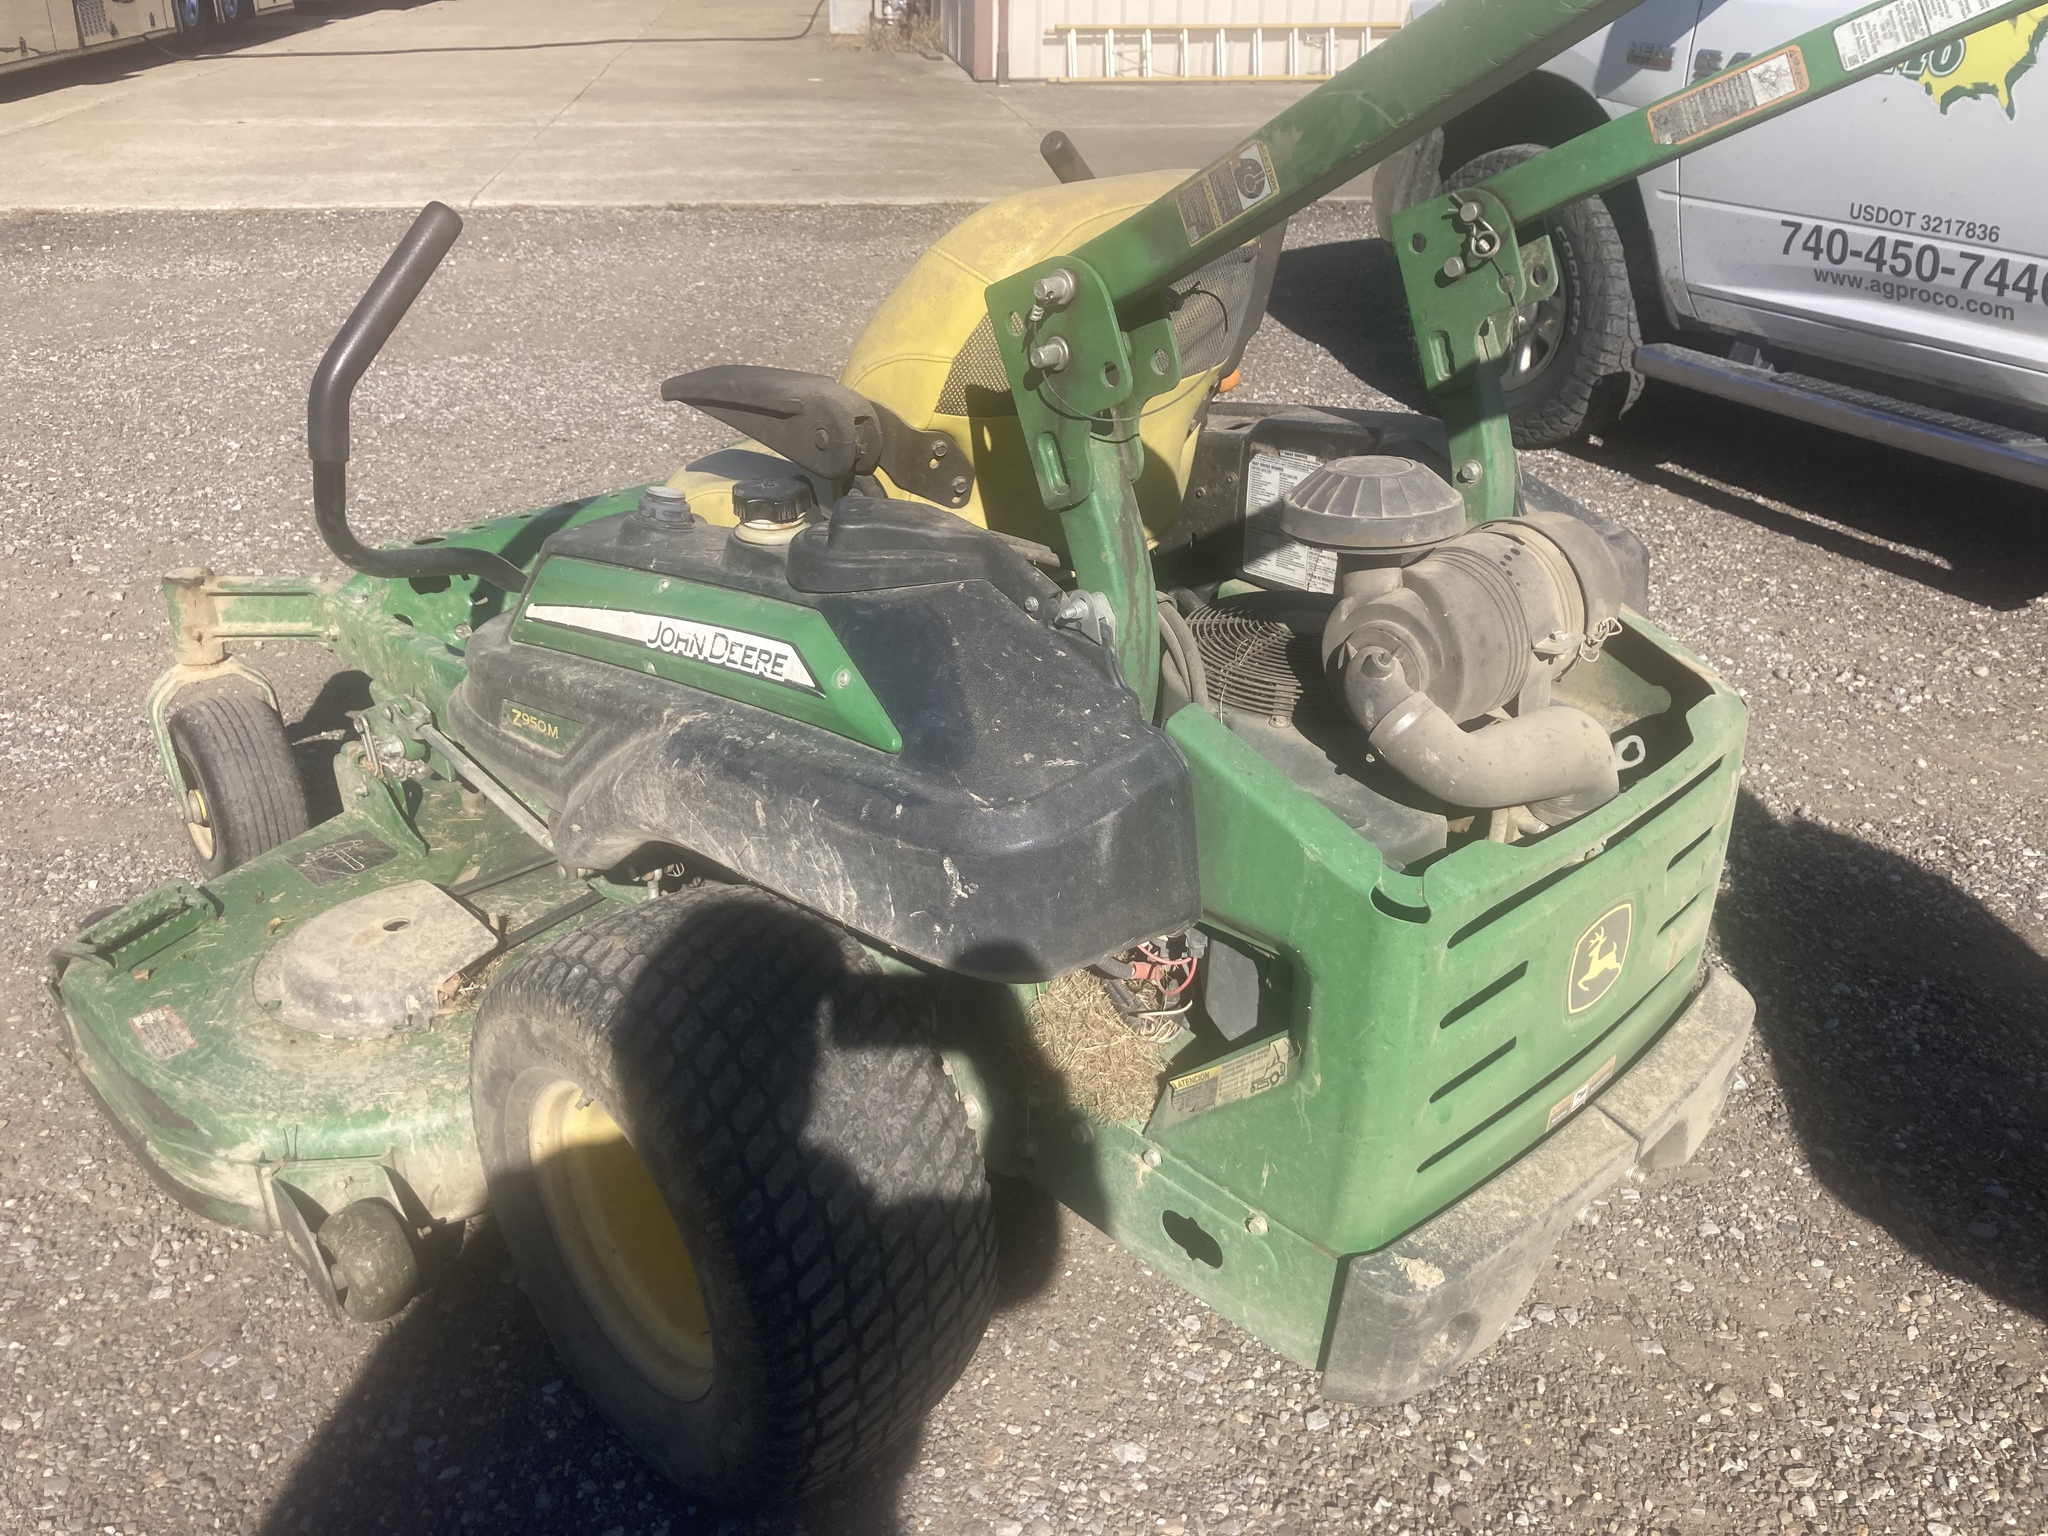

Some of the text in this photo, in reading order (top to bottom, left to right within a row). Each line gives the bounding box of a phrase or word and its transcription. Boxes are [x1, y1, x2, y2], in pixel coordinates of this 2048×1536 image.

[1849, 202, 2000, 243] USDOT 3217836
[1814, 268, 2015, 321] www.agproco.com
[647, 620, 788, 677] JOHN DEERE
[511, 708, 559, 739] Z950M
